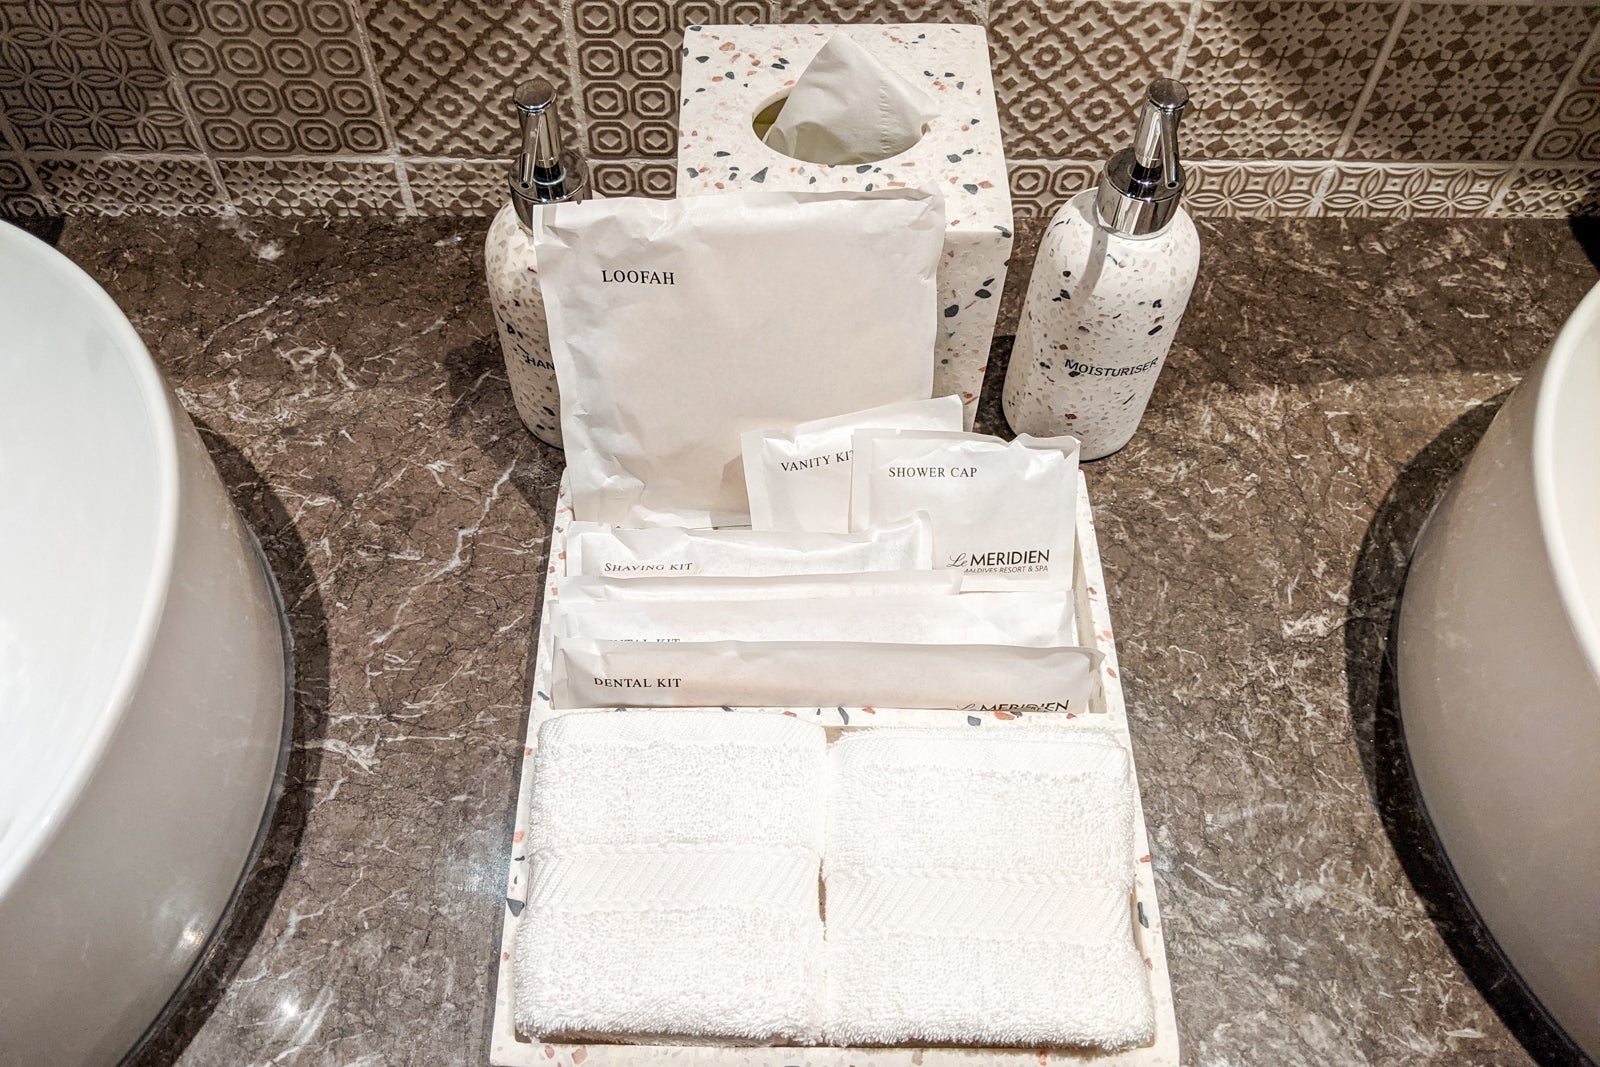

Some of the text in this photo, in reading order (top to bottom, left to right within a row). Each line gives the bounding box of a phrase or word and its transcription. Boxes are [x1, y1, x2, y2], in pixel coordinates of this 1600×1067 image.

[601, 264, 675, 285] LOOFAH
[526, 355, 555, 371] HAN
[1064, 357, 1159, 378] MOISTURISER
[780, 454, 831, 472] VANITY
[888, 466, 978, 478] SHOWER CAP
[946, 549, 1050, 568] Le MERIDIEN
[999, 565, 1026, 574] RESORT
[1034, 564, 1049, 572] SPA
[593, 677, 682, 688] DENTAL KIT
